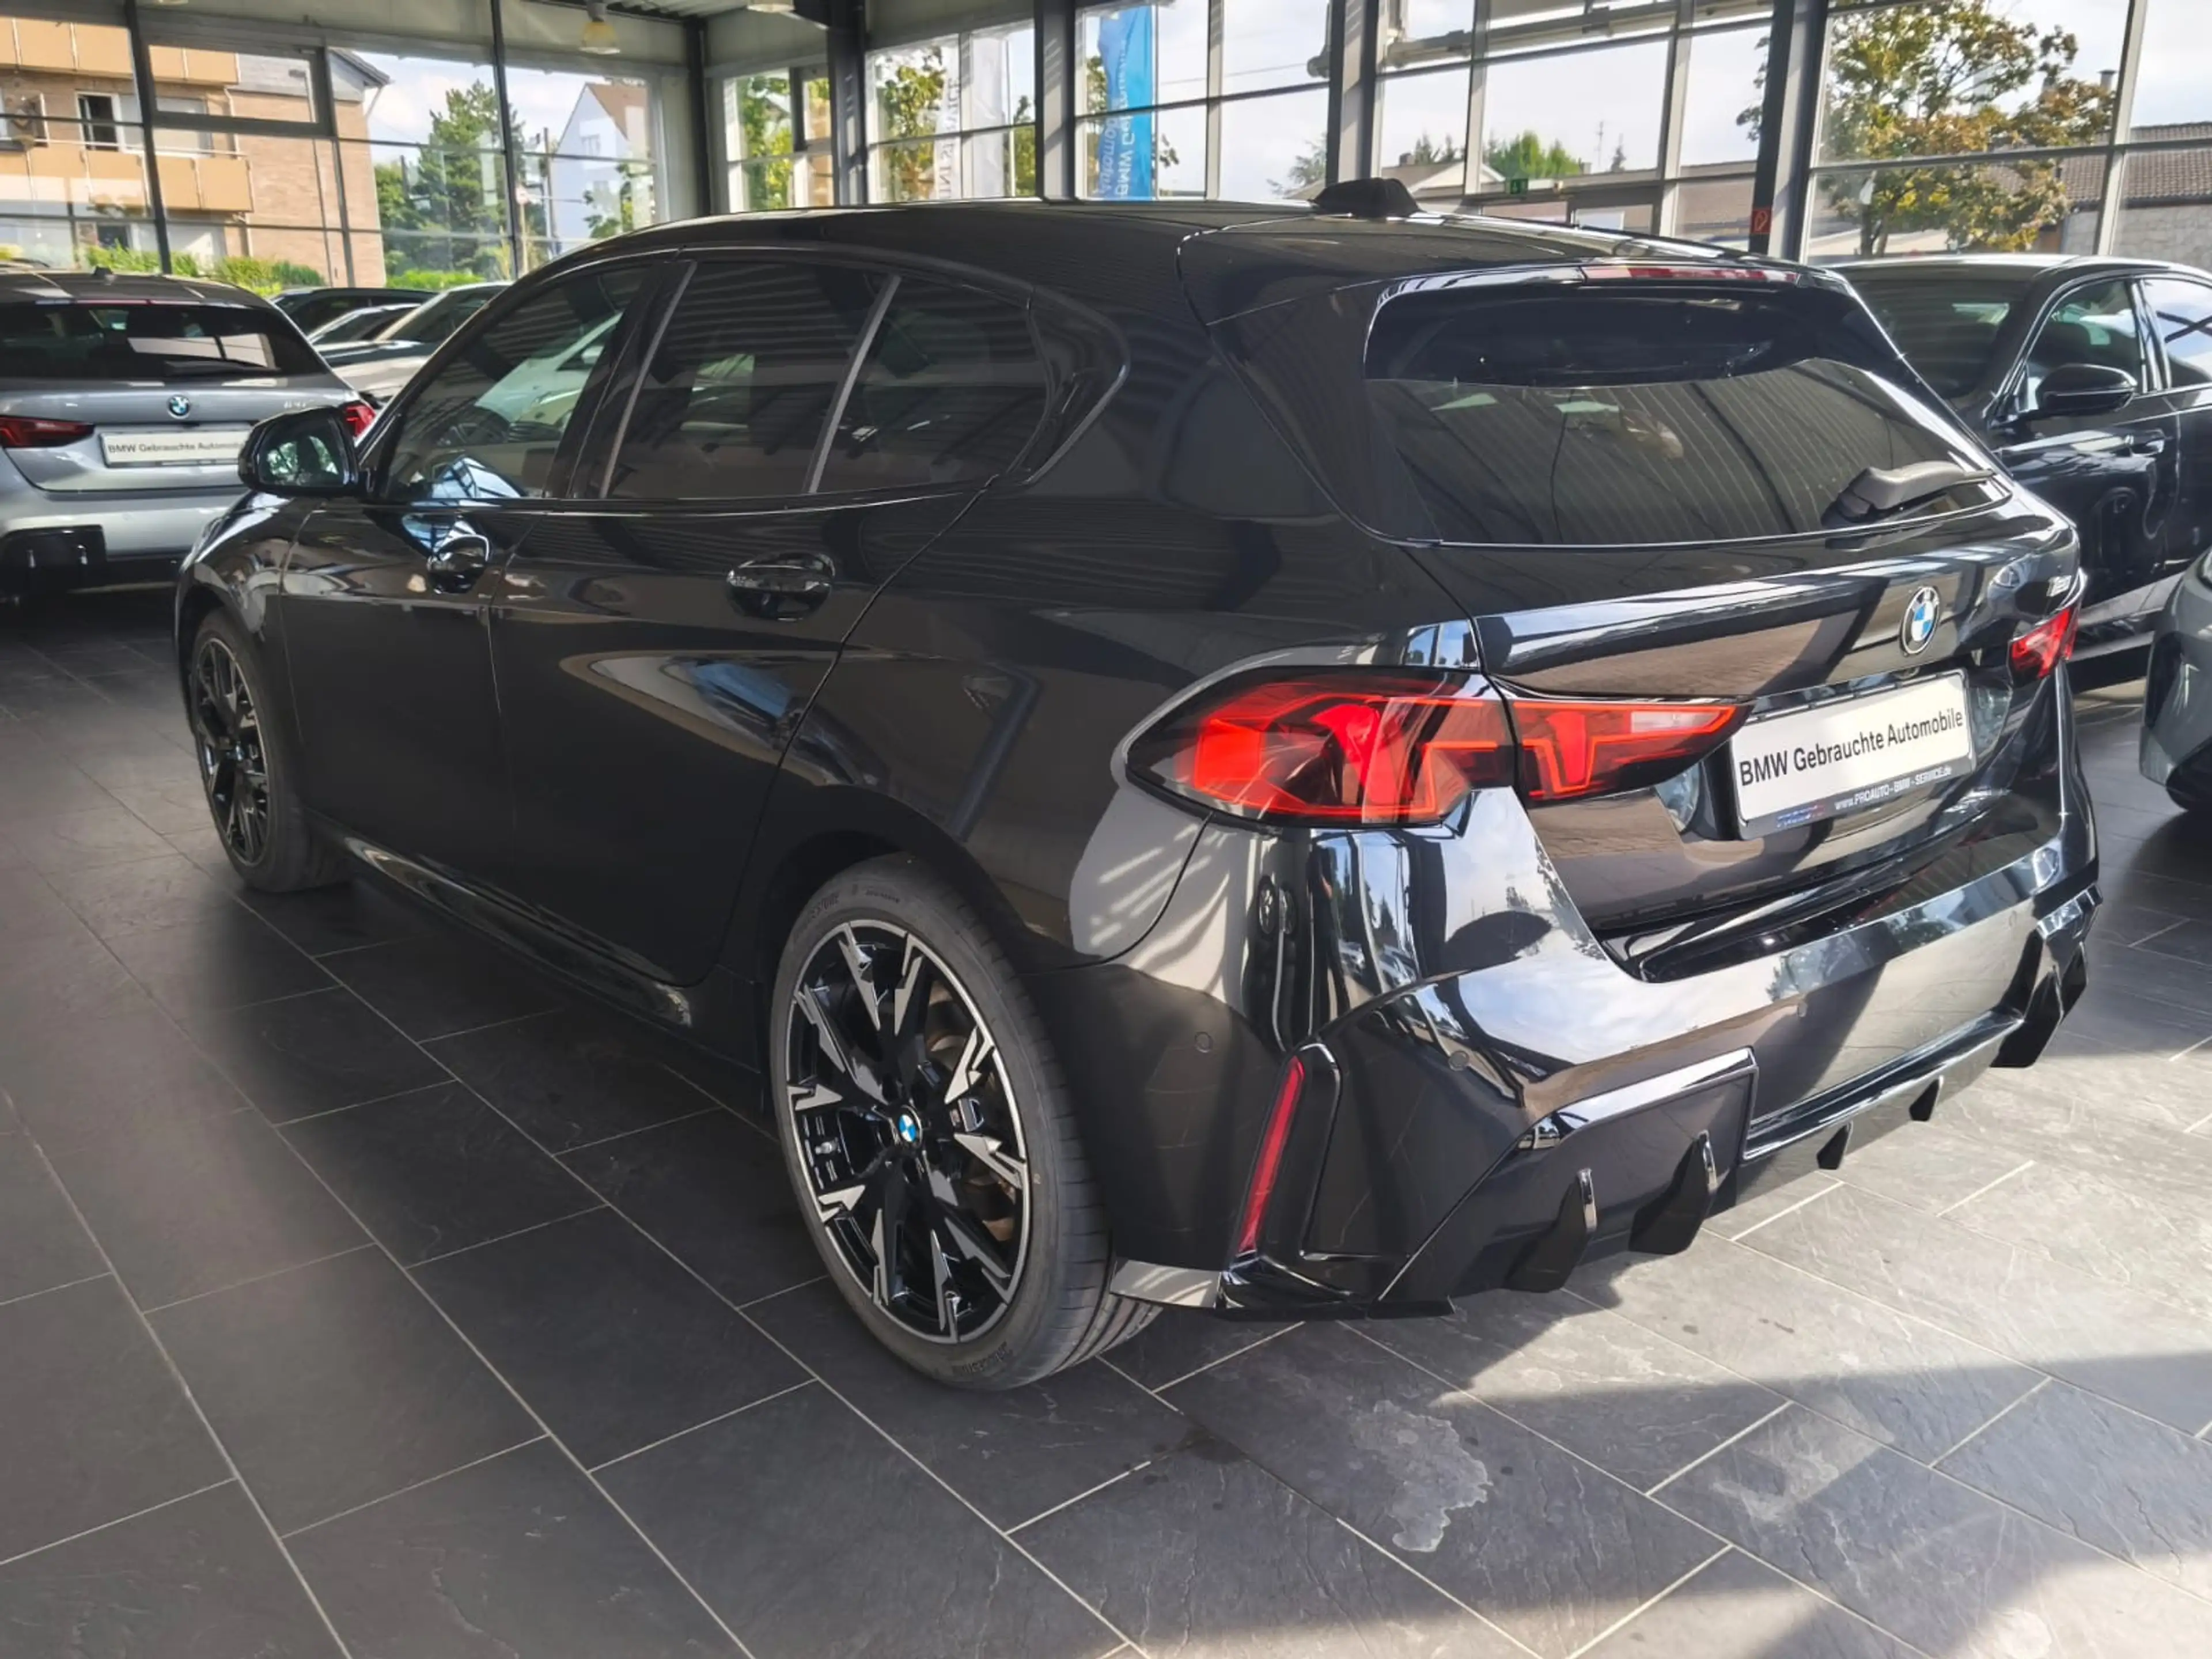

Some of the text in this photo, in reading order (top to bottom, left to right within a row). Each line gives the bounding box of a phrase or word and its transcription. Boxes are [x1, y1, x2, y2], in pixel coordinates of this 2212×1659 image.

[108, 444, 137, 453] BMW
[198, 442, 245, 450] Automob
[1740, 708, 1964, 787] BMW Gebrauchte Automobile
